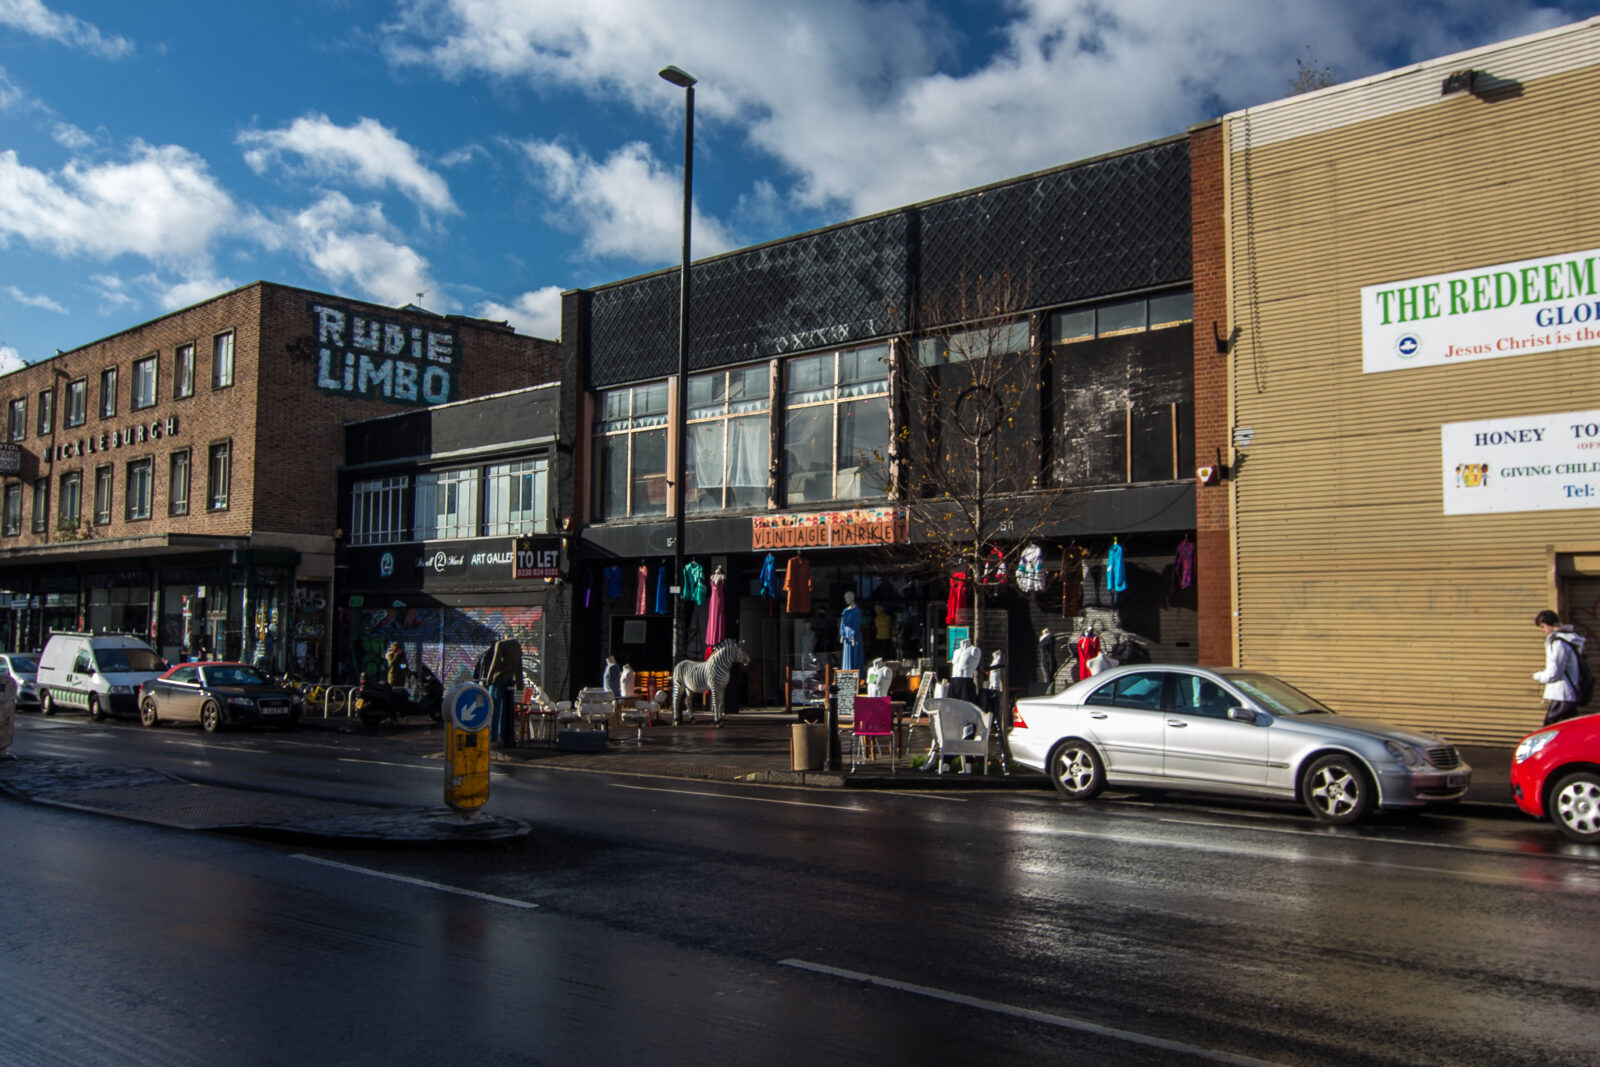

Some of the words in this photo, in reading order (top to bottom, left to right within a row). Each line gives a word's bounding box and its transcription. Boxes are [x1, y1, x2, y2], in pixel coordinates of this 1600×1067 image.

[1376, 282, 1442, 325] THE
[1447, 256, 1600, 316] REDEEM
[1445, 343, 1492, 358] Jesus
[1496, 332, 1552, 352] Christ
[1557, 330, 1571, 344] is
[1474, 428, 1546, 447] HONEY
[1570, 423, 1600, 438] TO
[1500, 465, 1552, 478] GIVING
[1563, 483, 1596, 498] Tel:
[754, 525, 827, 545] VINTAGE
[831, 521, 906, 543] MARKET
[471, 552, 486, 566] ART
[517, 550, 534, 568] TO
[537, 550, 559, 568] LET
